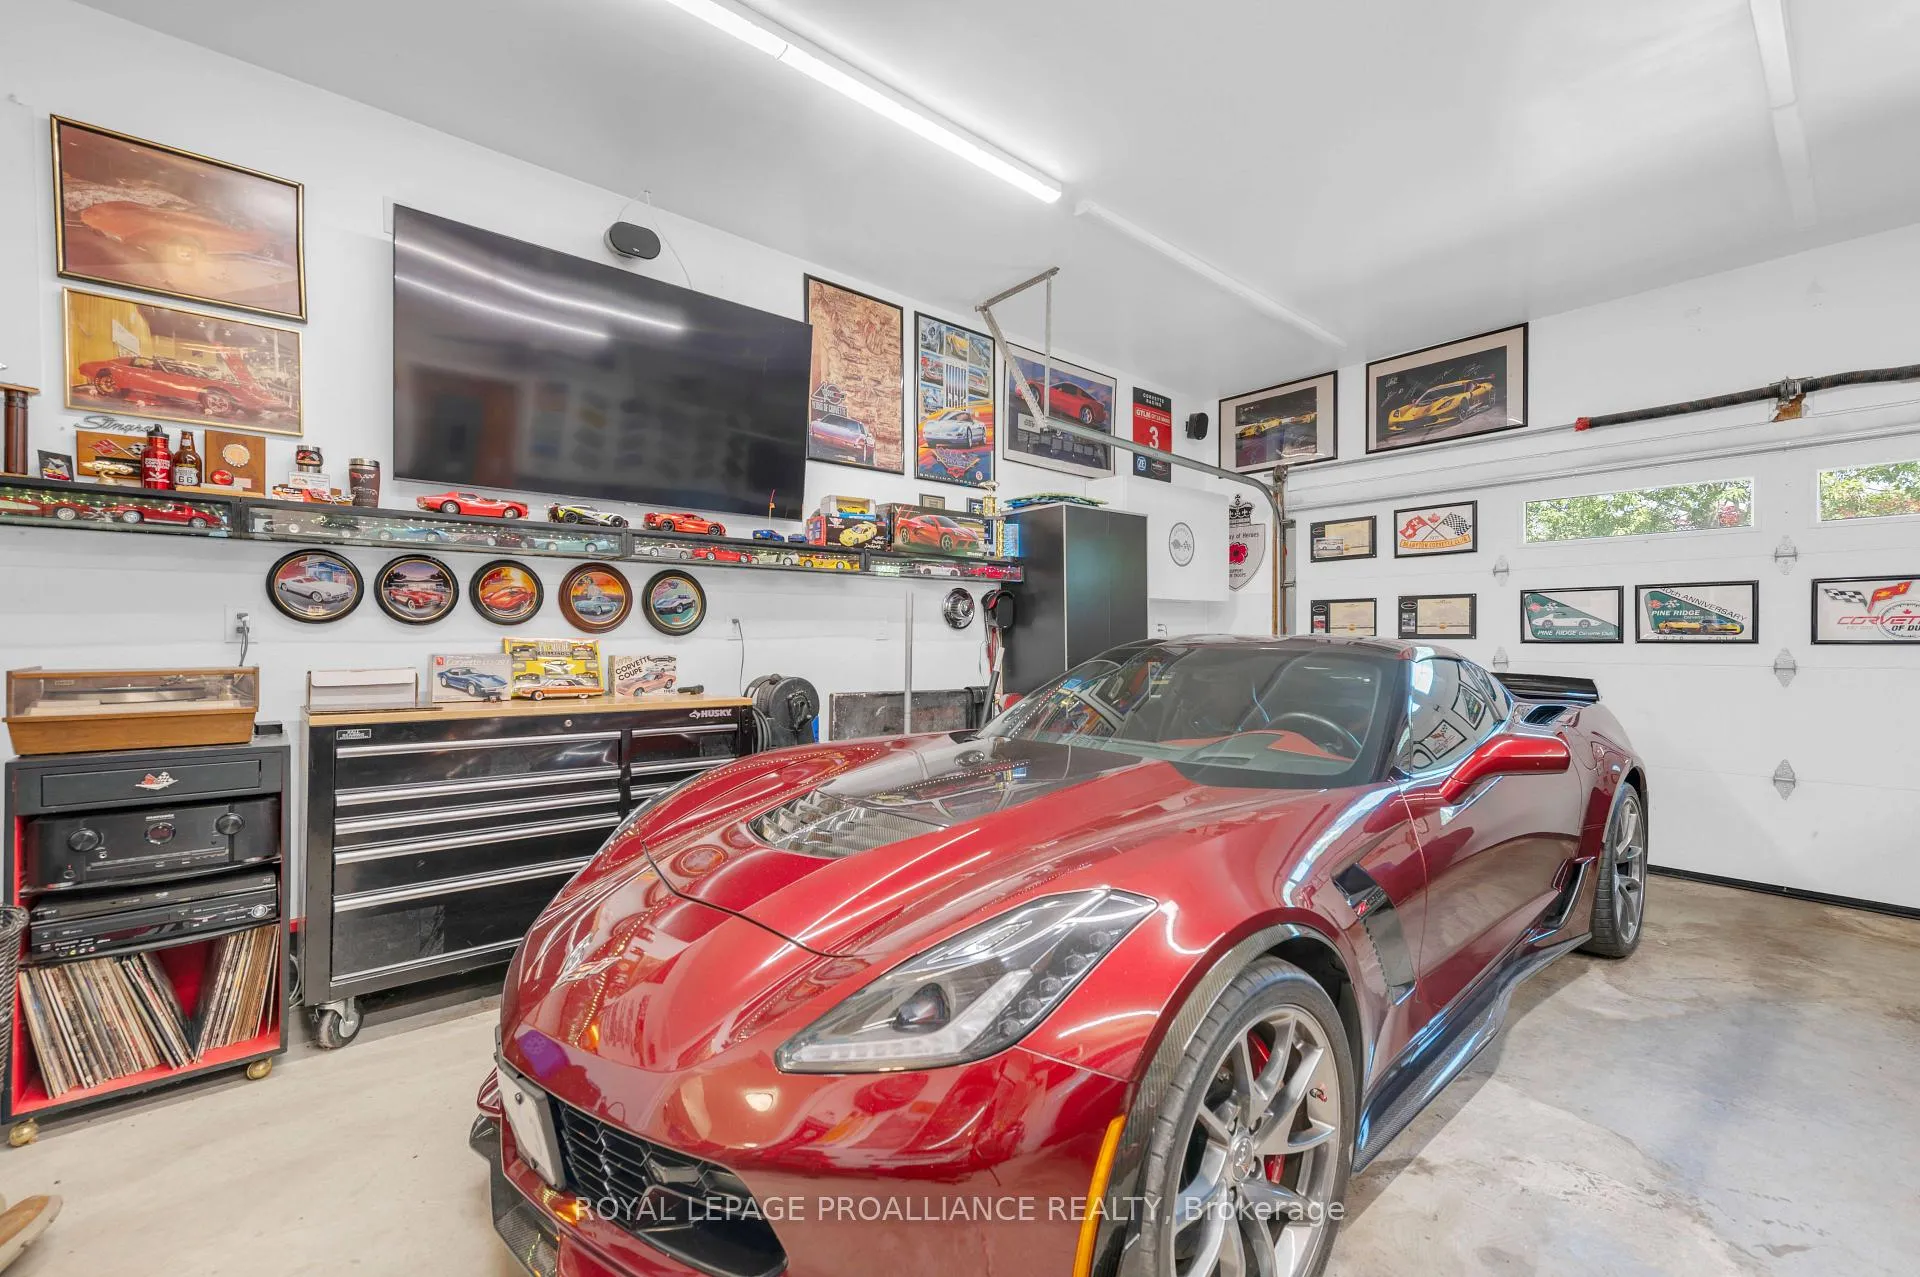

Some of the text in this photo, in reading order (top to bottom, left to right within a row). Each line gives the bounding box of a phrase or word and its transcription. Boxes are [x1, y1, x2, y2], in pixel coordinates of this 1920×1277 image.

[74, 415, 152, 433] Stingra
[1149, 426, 1159, 449] 3
[1680, 594, 1748, 622] ANNIVERSARY
[616, 655, 650, 674] CORVETTE
[618, 667, 643, 680] COUPE
[700, 709, 731, 717] HUSKY
